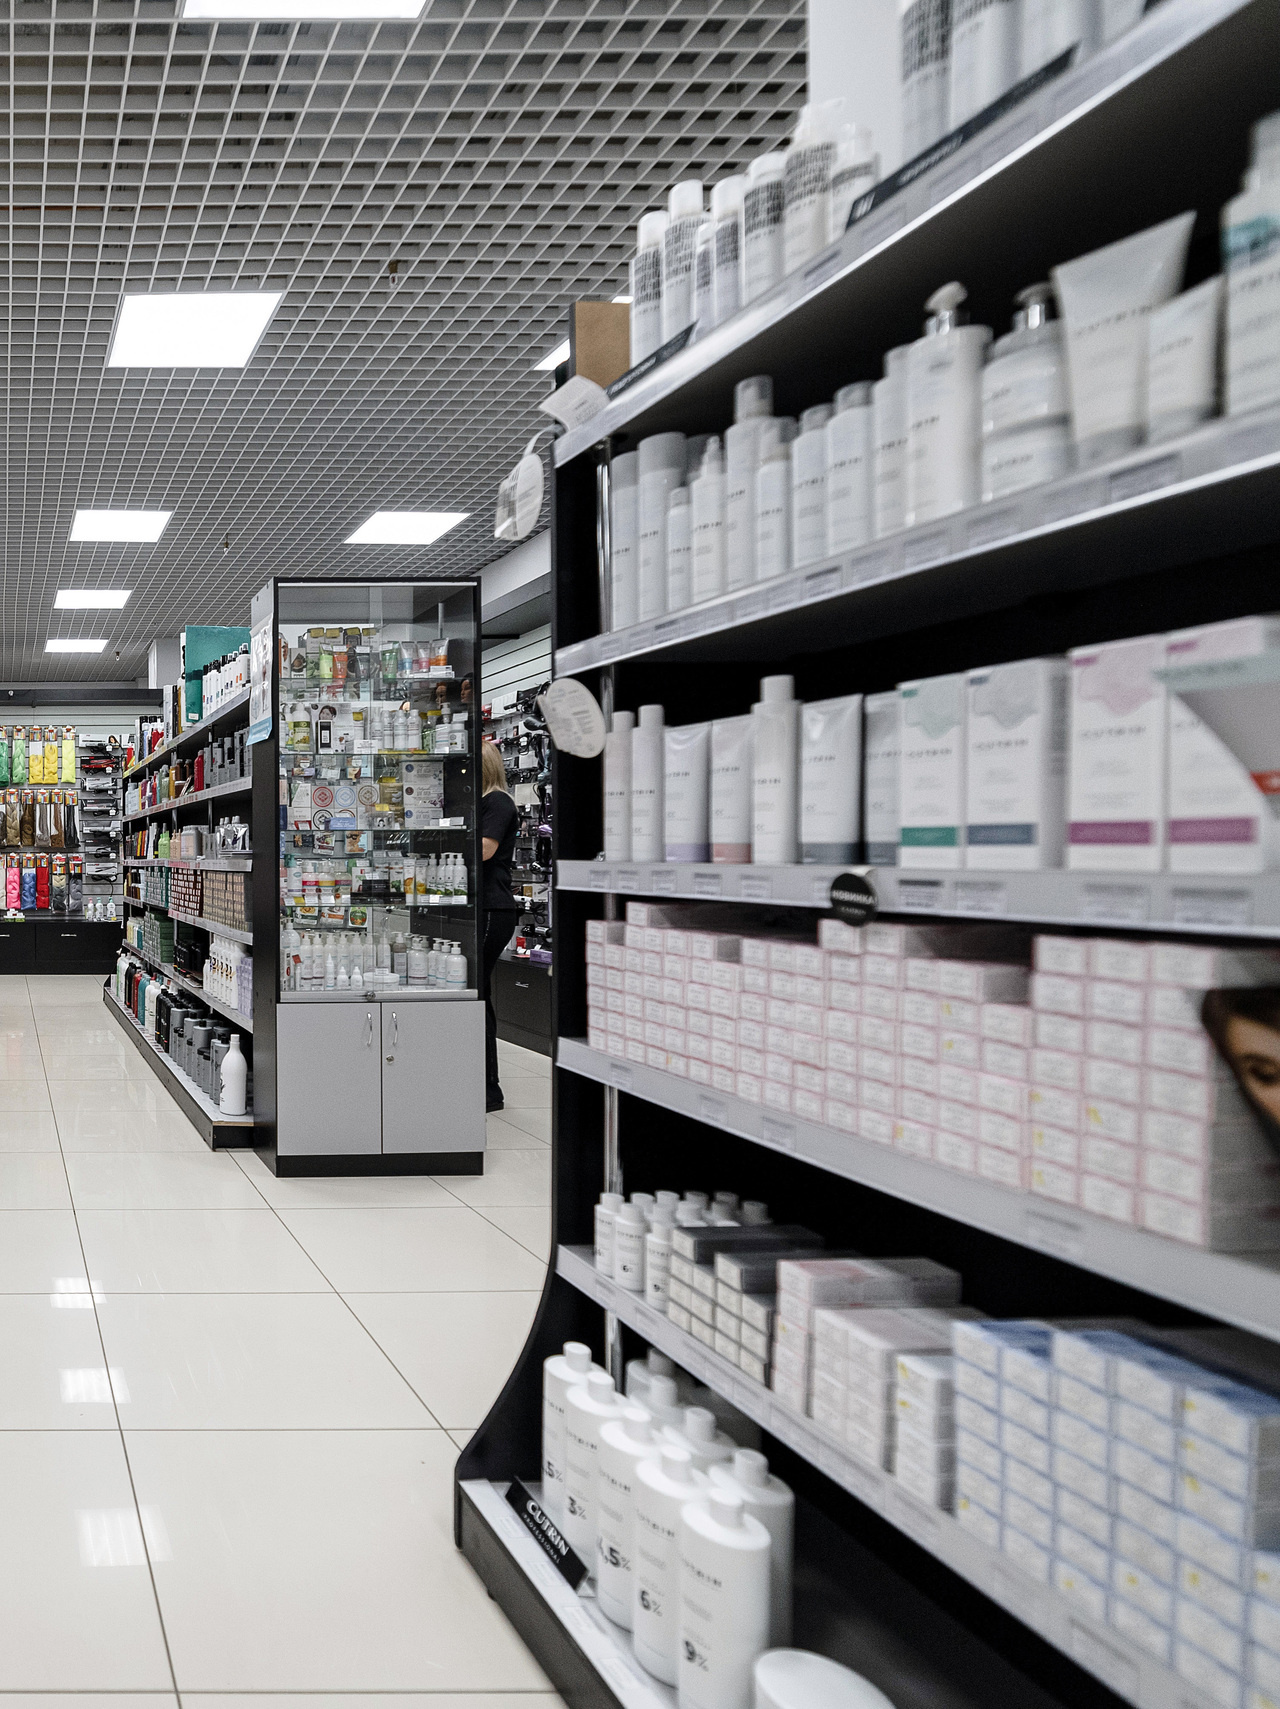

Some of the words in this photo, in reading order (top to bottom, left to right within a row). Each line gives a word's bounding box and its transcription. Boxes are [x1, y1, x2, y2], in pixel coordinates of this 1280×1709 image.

[568, 1495, 587, 1520] 3%
[521, 1512, 561, 1565] PROFESSIONAL
[526, 1499, 570, 1557] CUTRIN
[640, 1589, 663, 1618] 6%
[683, 1639, 710, 1673] 9%
